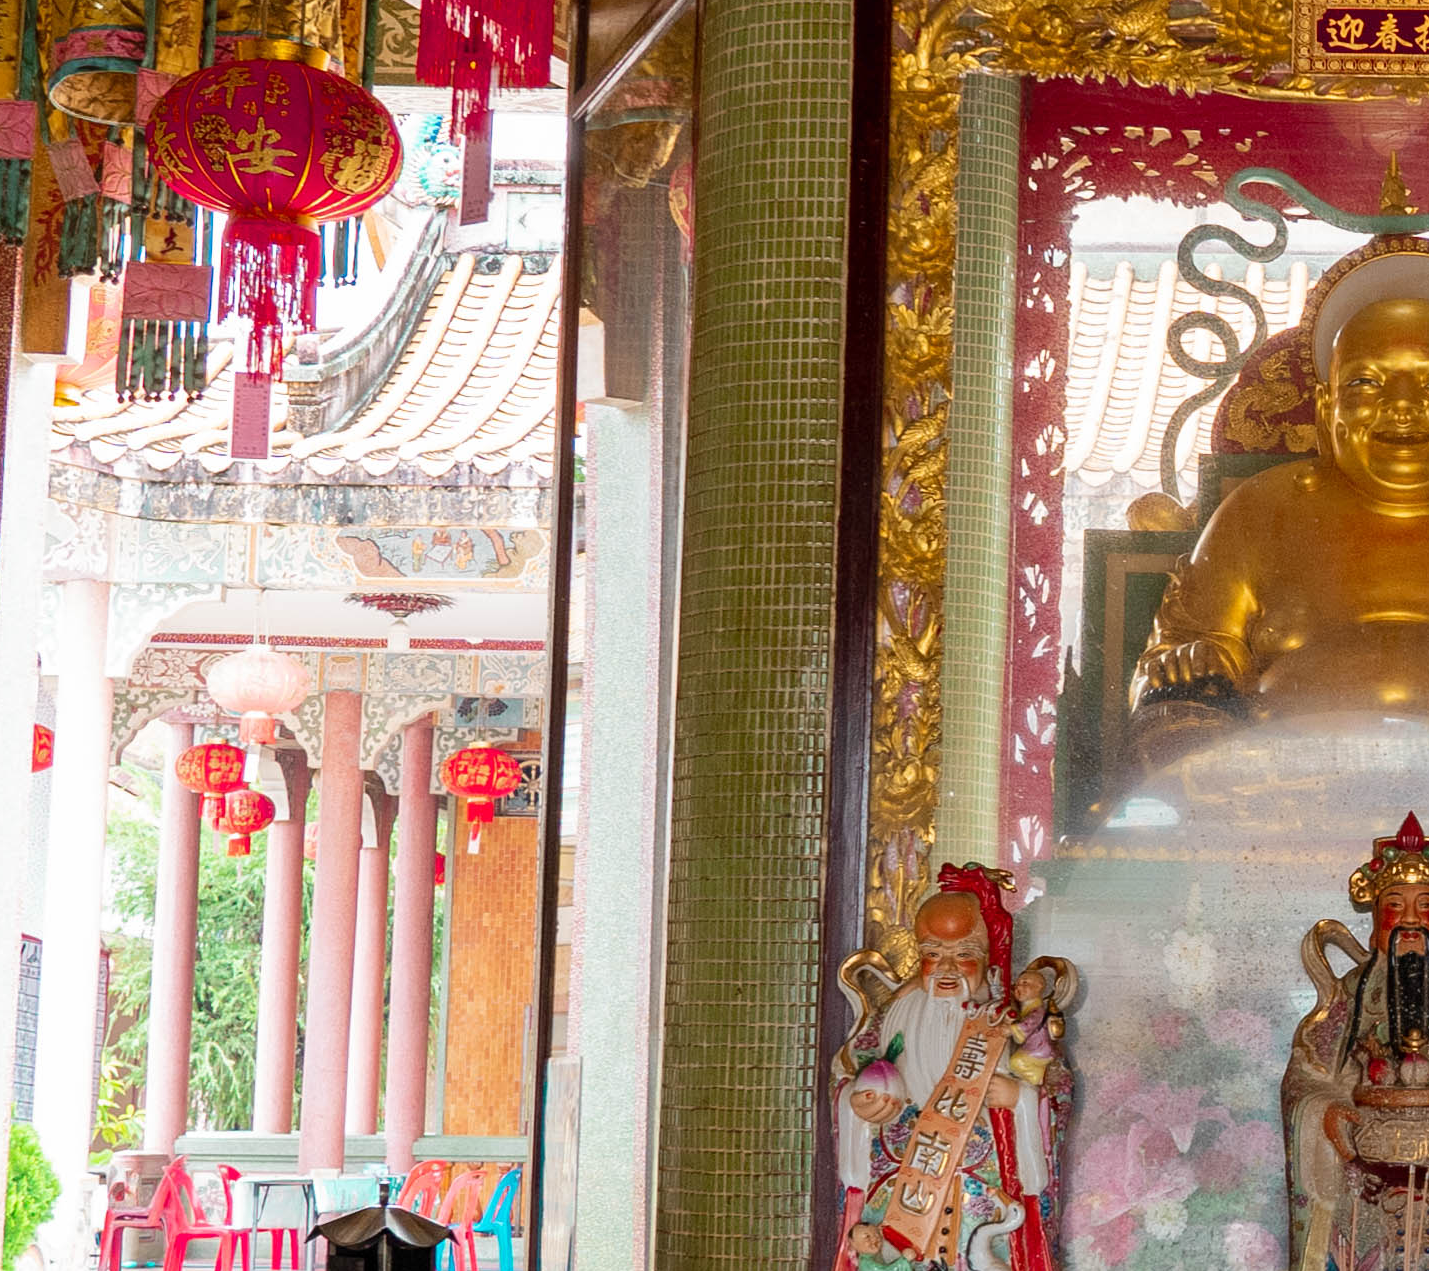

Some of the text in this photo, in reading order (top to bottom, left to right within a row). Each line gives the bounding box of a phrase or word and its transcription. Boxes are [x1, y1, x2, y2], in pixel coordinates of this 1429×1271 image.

[200, 67, 298, 176] 平安
[900, 1033, 988, 1216] 壽比南山
